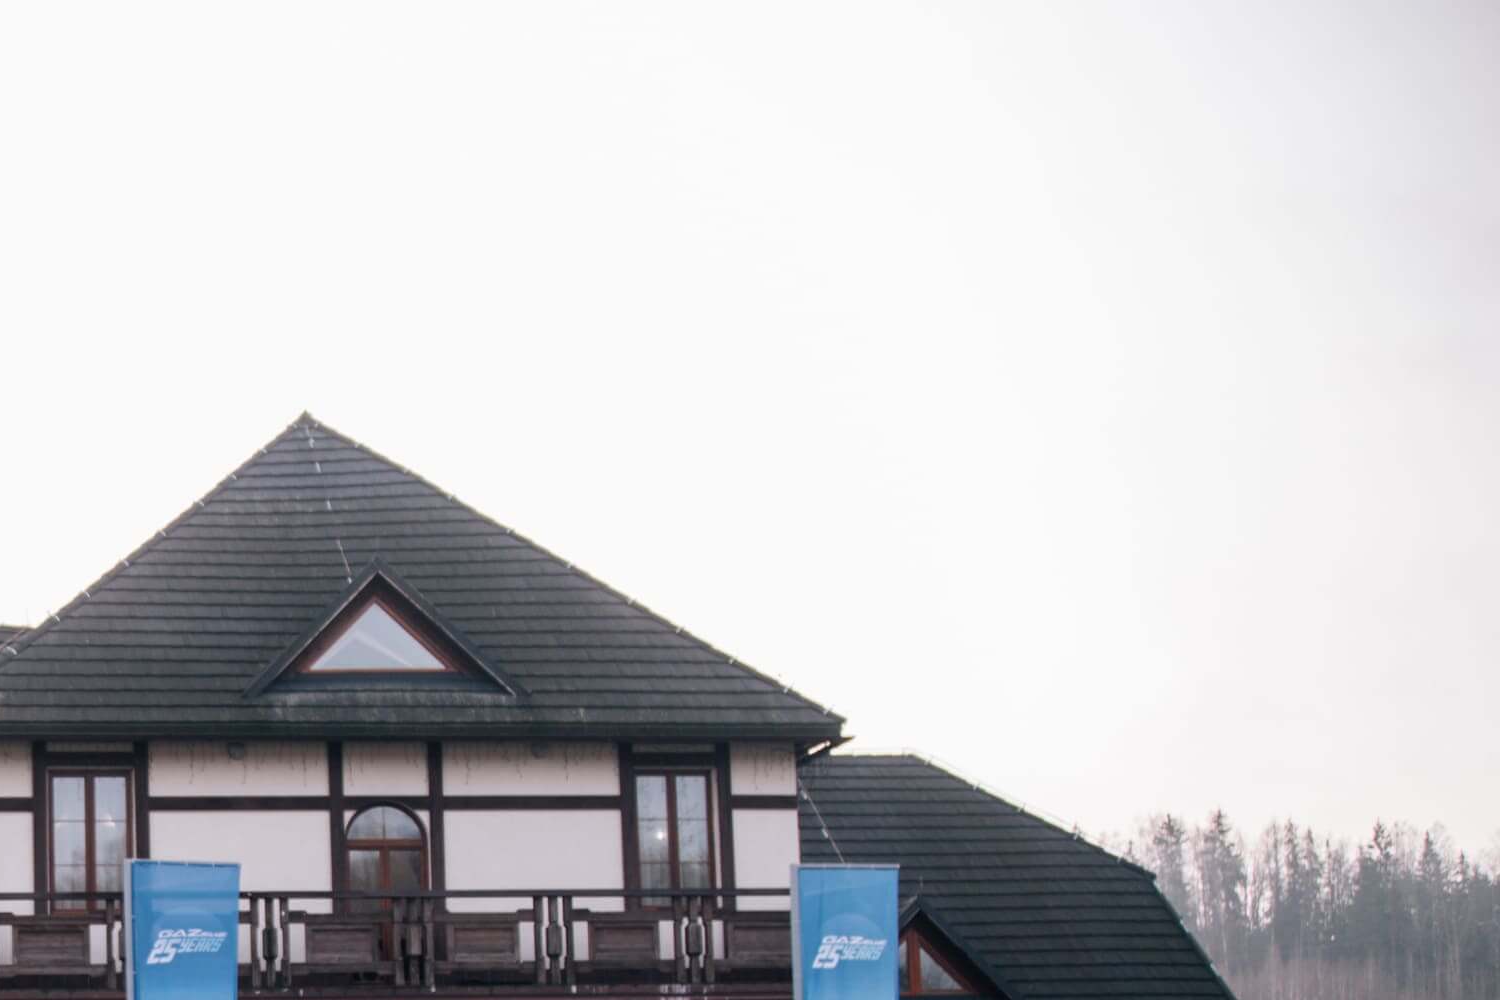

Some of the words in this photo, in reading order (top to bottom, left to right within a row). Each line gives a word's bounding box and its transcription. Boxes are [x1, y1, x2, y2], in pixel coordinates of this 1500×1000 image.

[146, 938, 182, 965] 25
[178, 938, 226, 953] YEARS
[812, 944, 844, 970] 25
